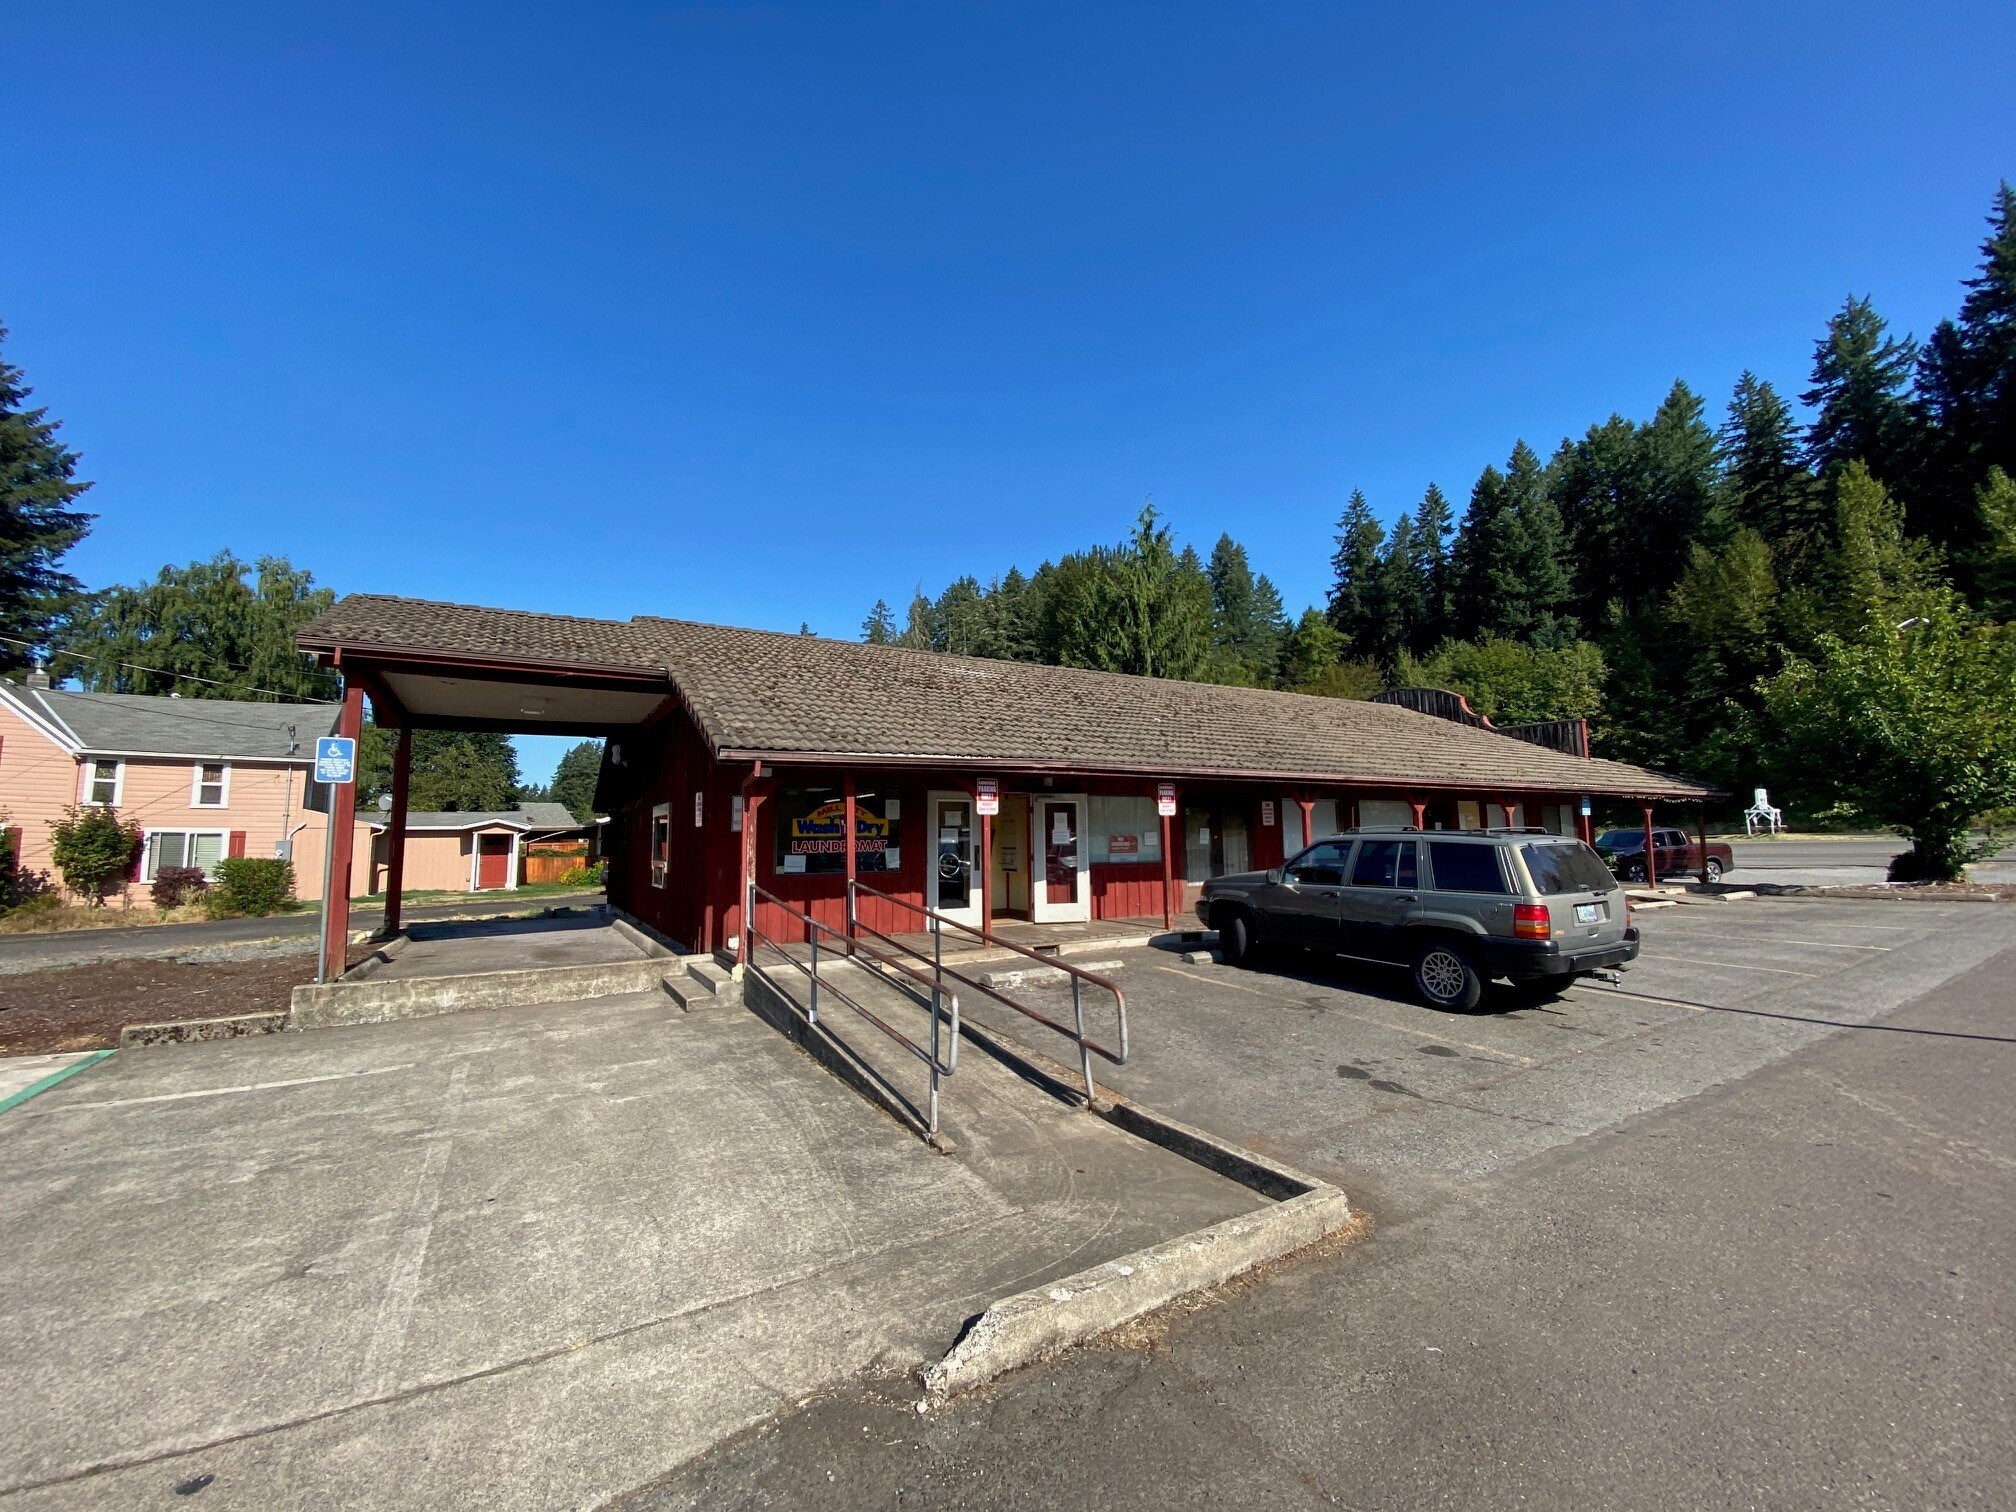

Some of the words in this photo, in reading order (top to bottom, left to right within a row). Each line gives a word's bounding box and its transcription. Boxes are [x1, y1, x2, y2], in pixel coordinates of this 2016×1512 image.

[817, 804, 841, 817] MILL
[797, 818, 840, 835] Wash
[856, 819, 885, 838] Dry
